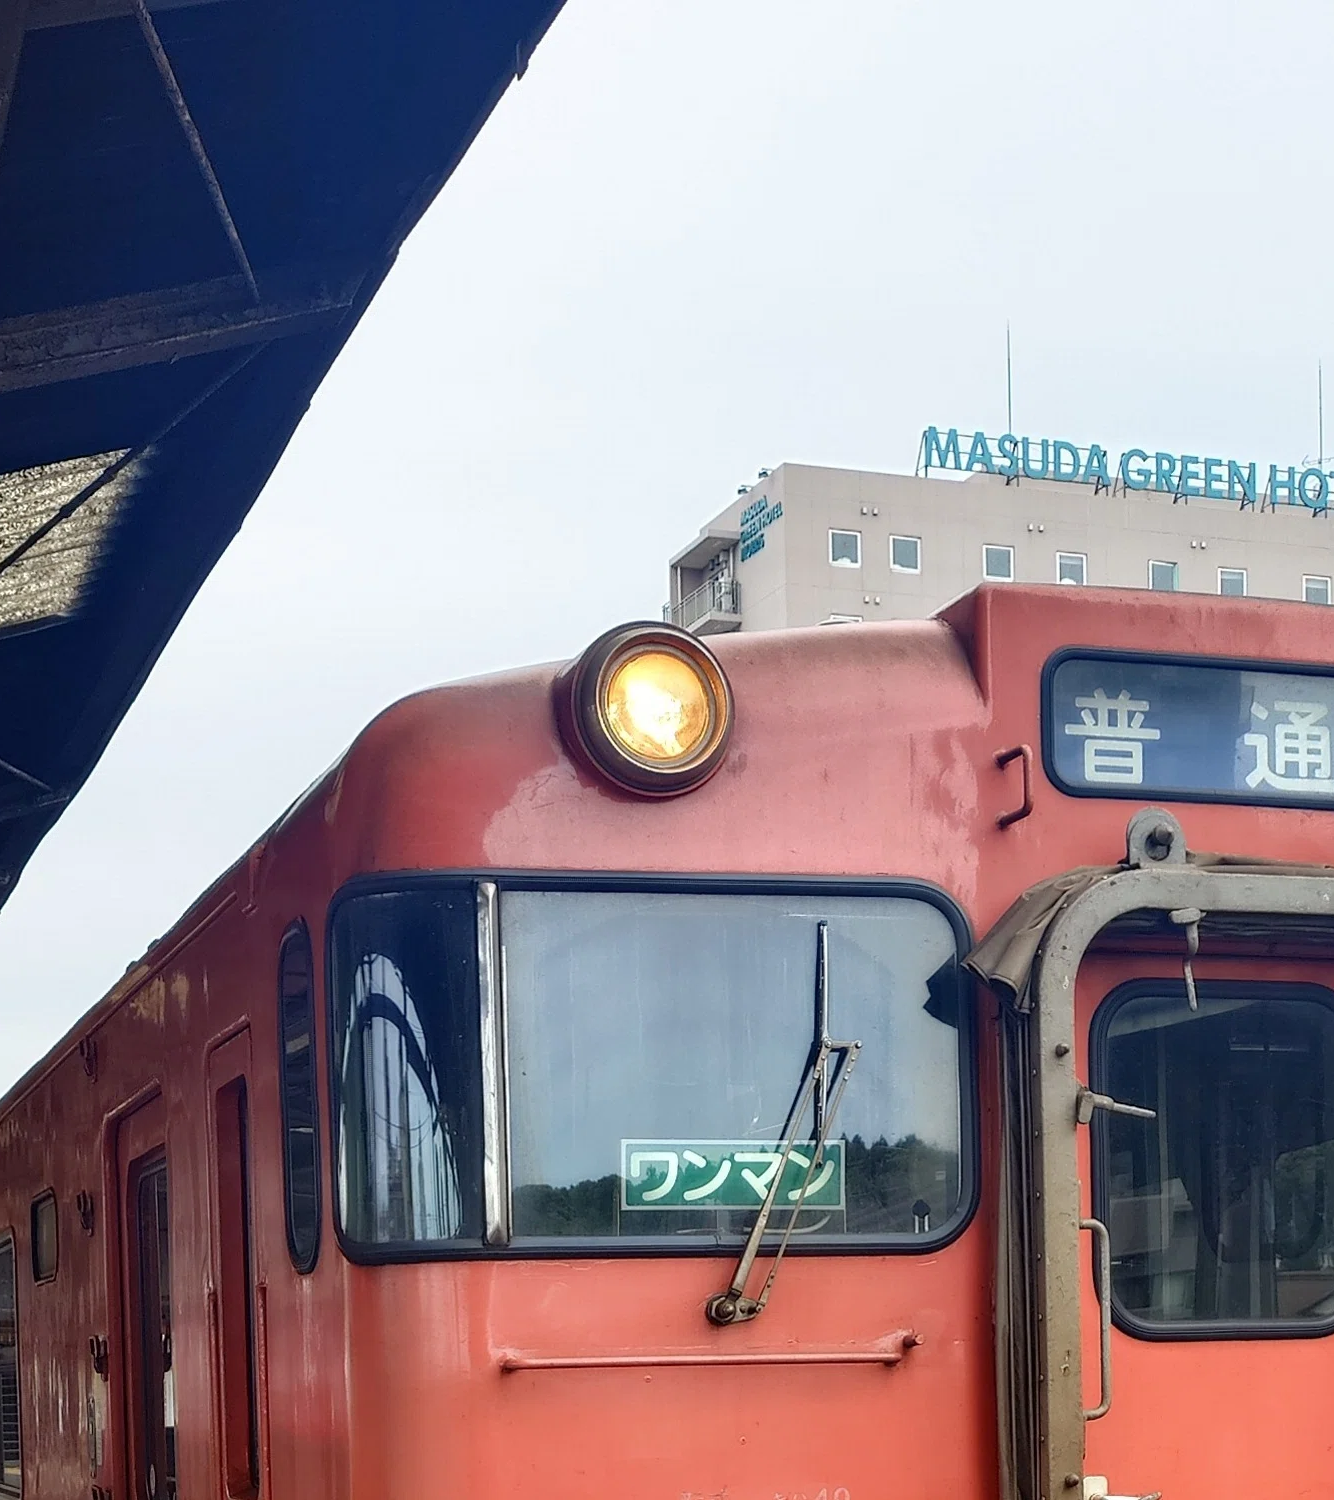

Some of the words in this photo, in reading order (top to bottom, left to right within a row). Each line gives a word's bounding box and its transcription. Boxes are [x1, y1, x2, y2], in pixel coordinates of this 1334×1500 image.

[924, 426, 1110, 487] MASUDA
[1122, 448, 1257, 503] GREEN
[630, 1149, 835, 1202] ワンマン
